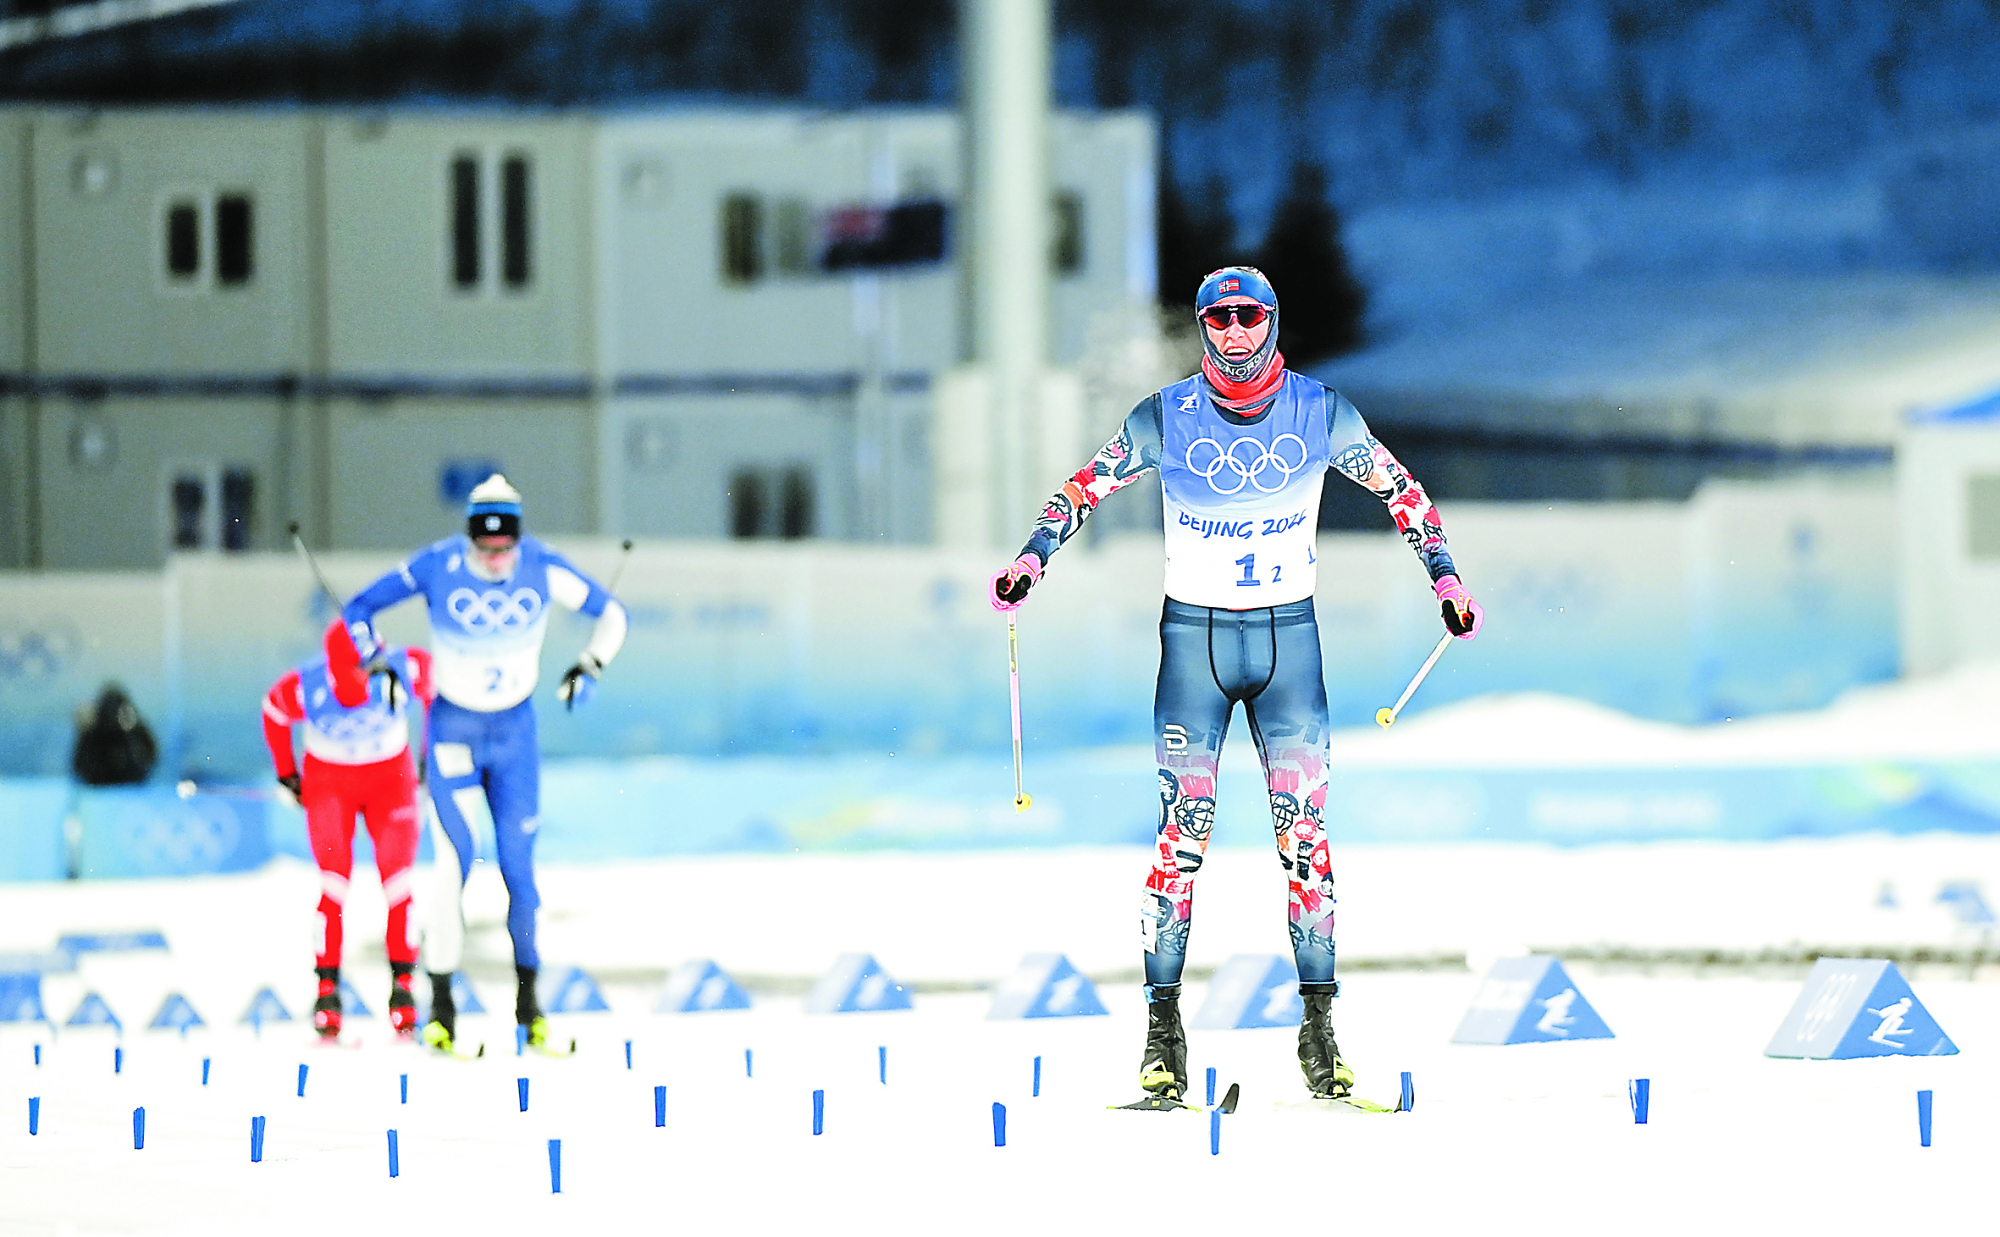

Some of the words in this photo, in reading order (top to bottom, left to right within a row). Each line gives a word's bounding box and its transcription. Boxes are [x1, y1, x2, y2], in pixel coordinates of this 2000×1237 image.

[1179, 510, 1254, 540] BEIJING
[1235, 553, 1261, 587] 1
[1270, 565, 1282, 583] 2
